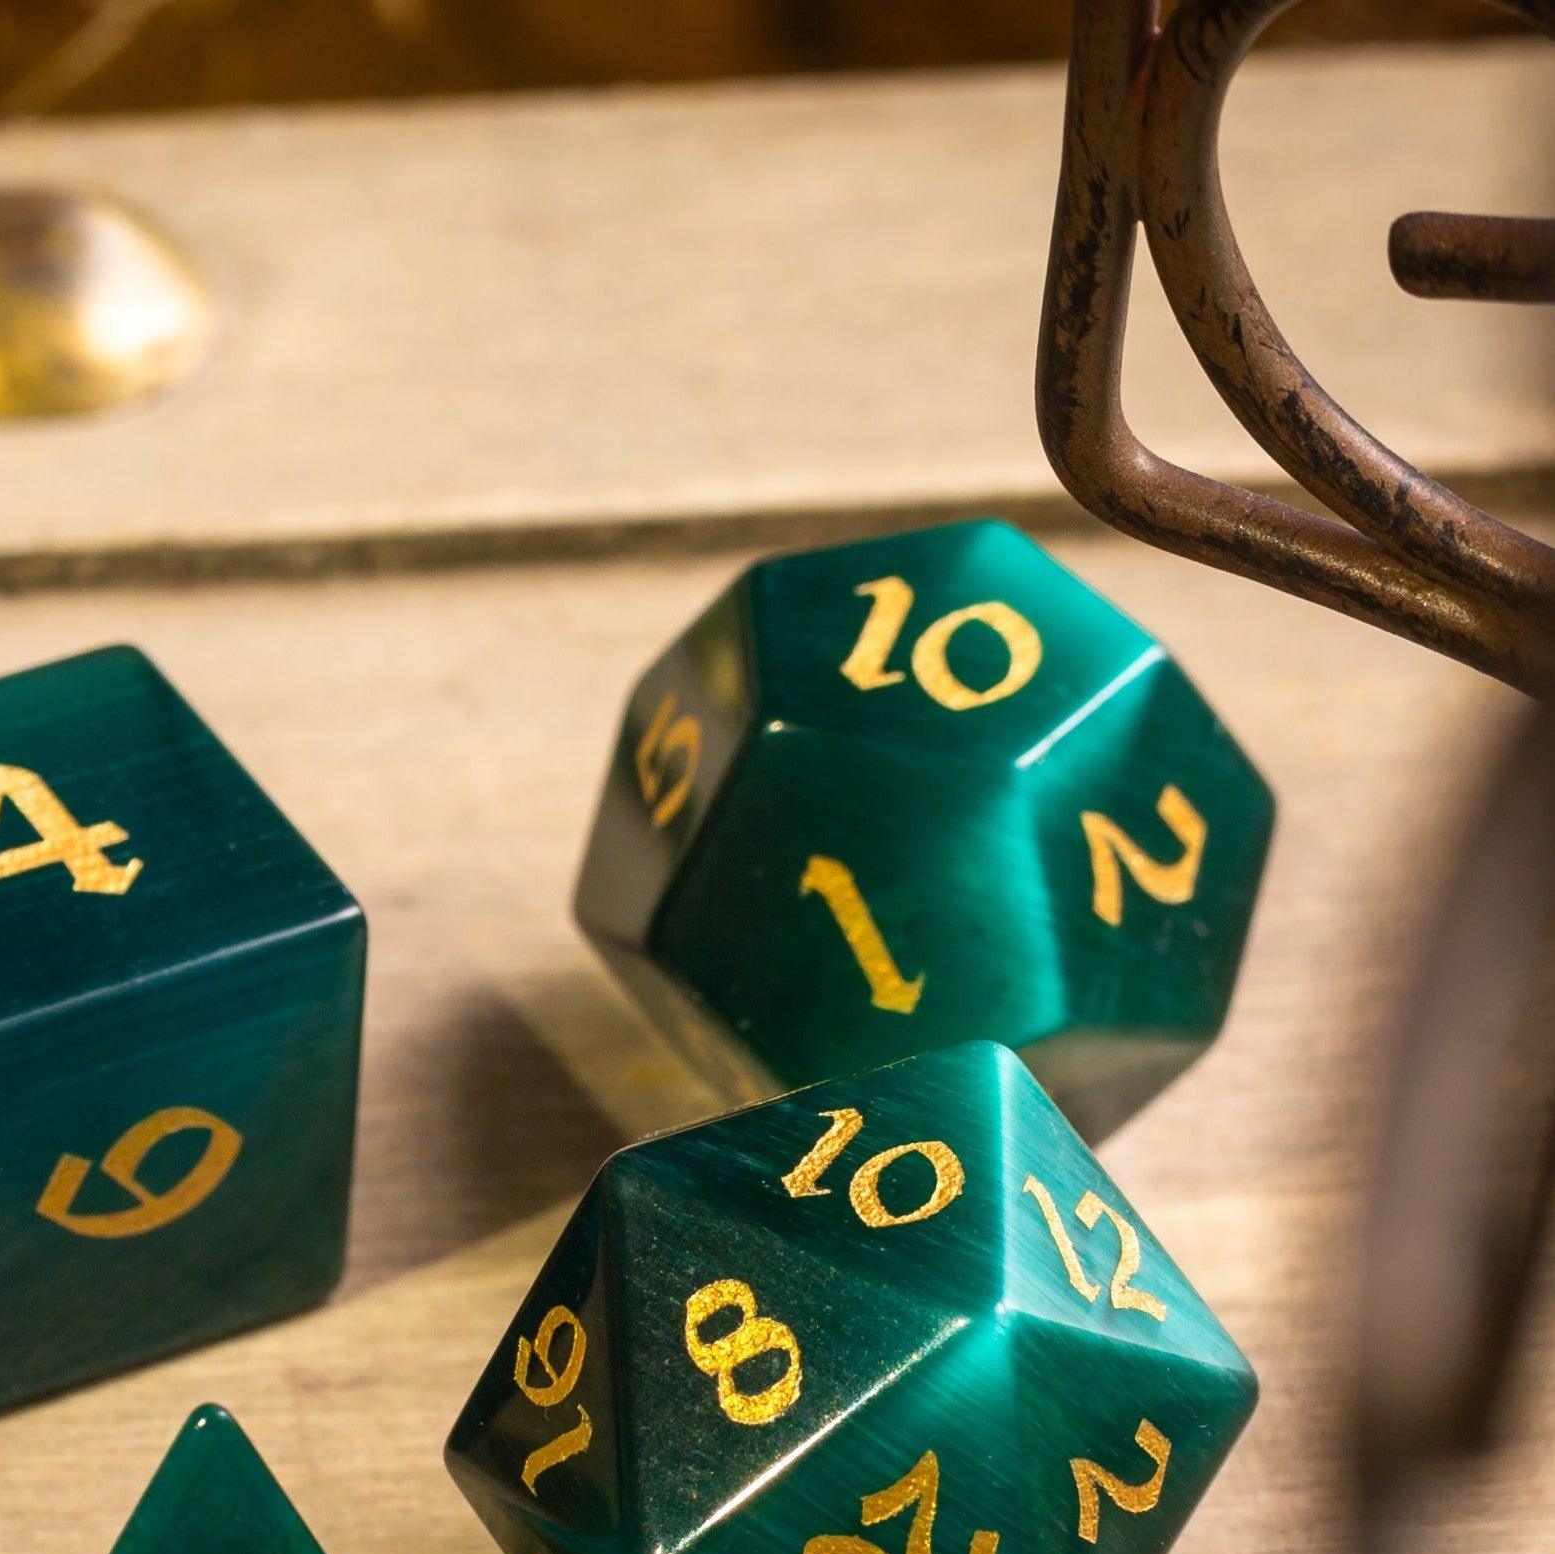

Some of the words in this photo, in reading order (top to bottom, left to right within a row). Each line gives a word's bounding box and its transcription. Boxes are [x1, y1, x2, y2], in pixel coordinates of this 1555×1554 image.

[841, 576, 1043, 711] 10
[1081, 785, 1208, 926] 2
[800, 855, 925, 1014] 1
[781, 1107, 966, 1229] 10
[1022, 1174, 1168, 1322] 12
[514, 1303, 594, 1498] 16
[683, 1278, 802, 1427] 8
[1070, 1418, 1172, 1545] 2
